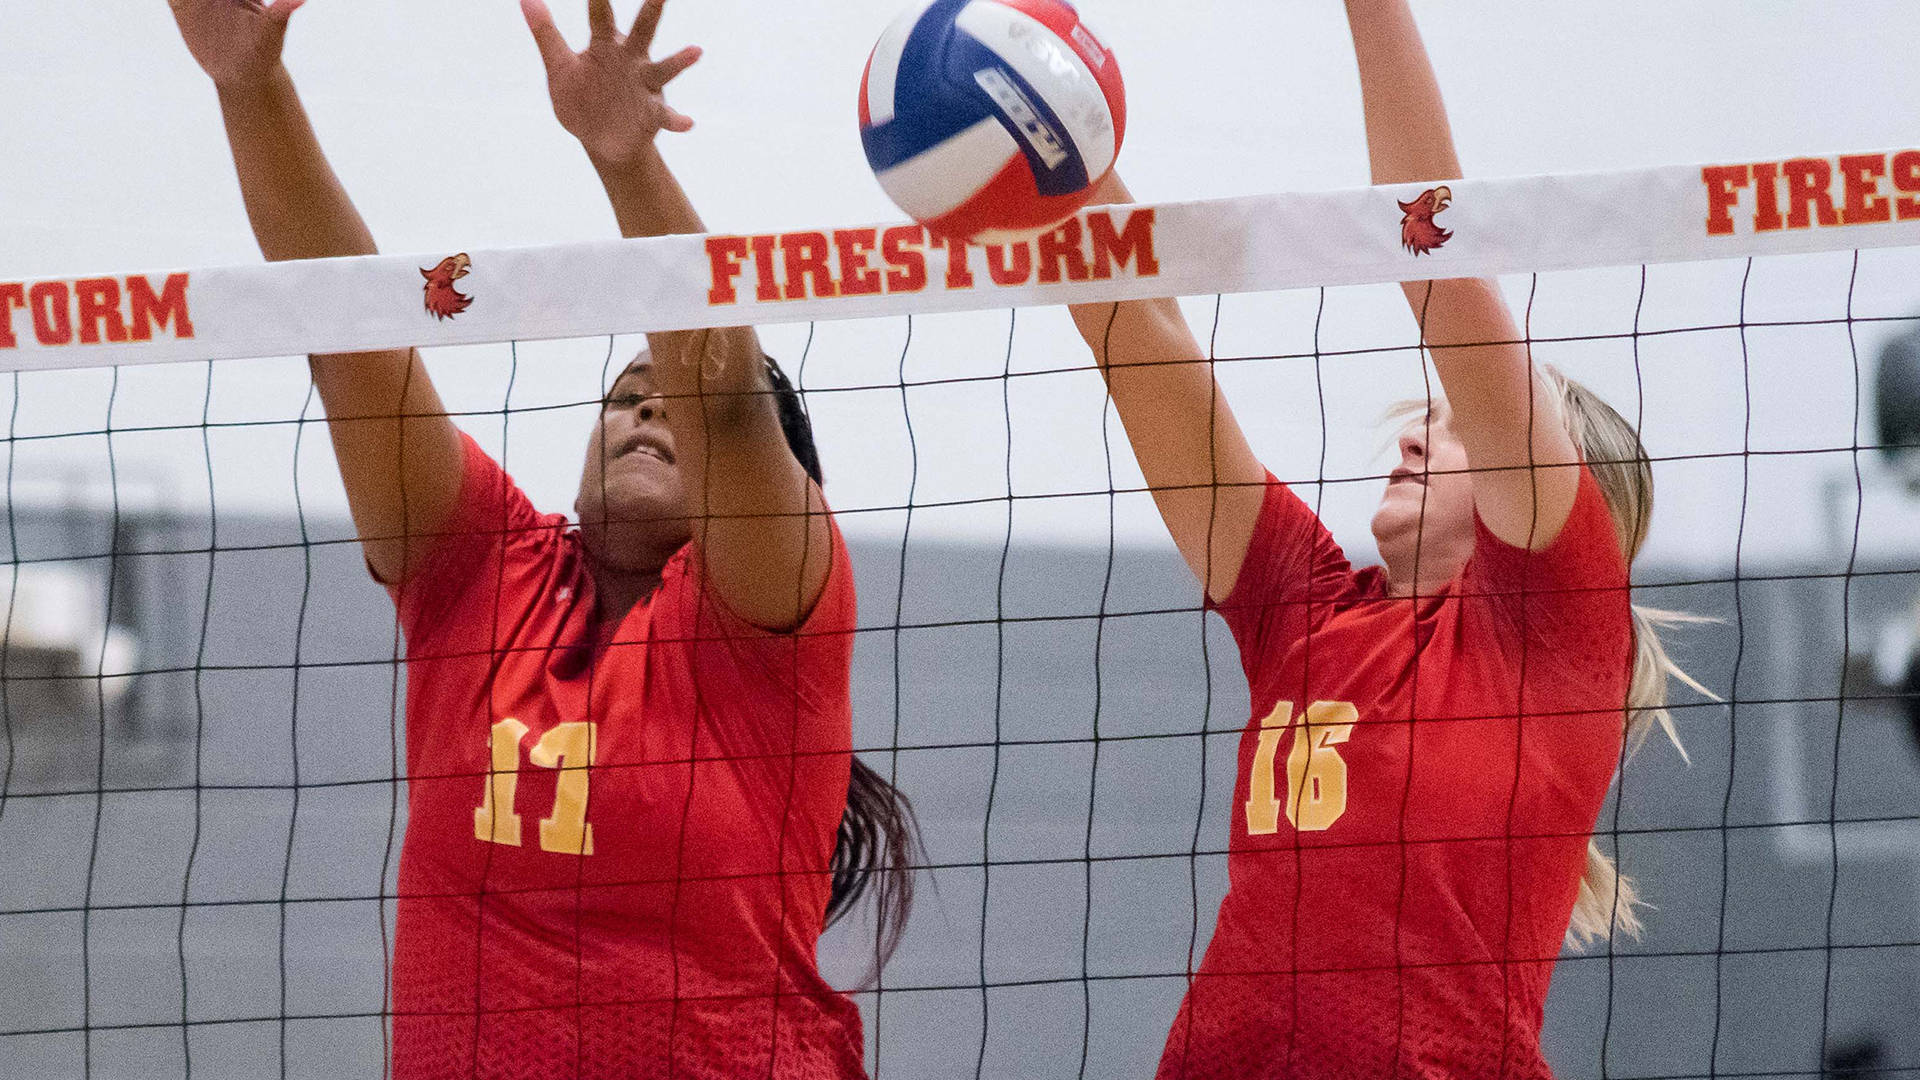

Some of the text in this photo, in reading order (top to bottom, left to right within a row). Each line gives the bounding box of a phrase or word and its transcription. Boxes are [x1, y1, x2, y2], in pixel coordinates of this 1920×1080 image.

[1701, 150, 1920, 237] FIRES
[705, 208, 1159, 306] FIRESTORM
[1245, 700, 1359, 835] 16
